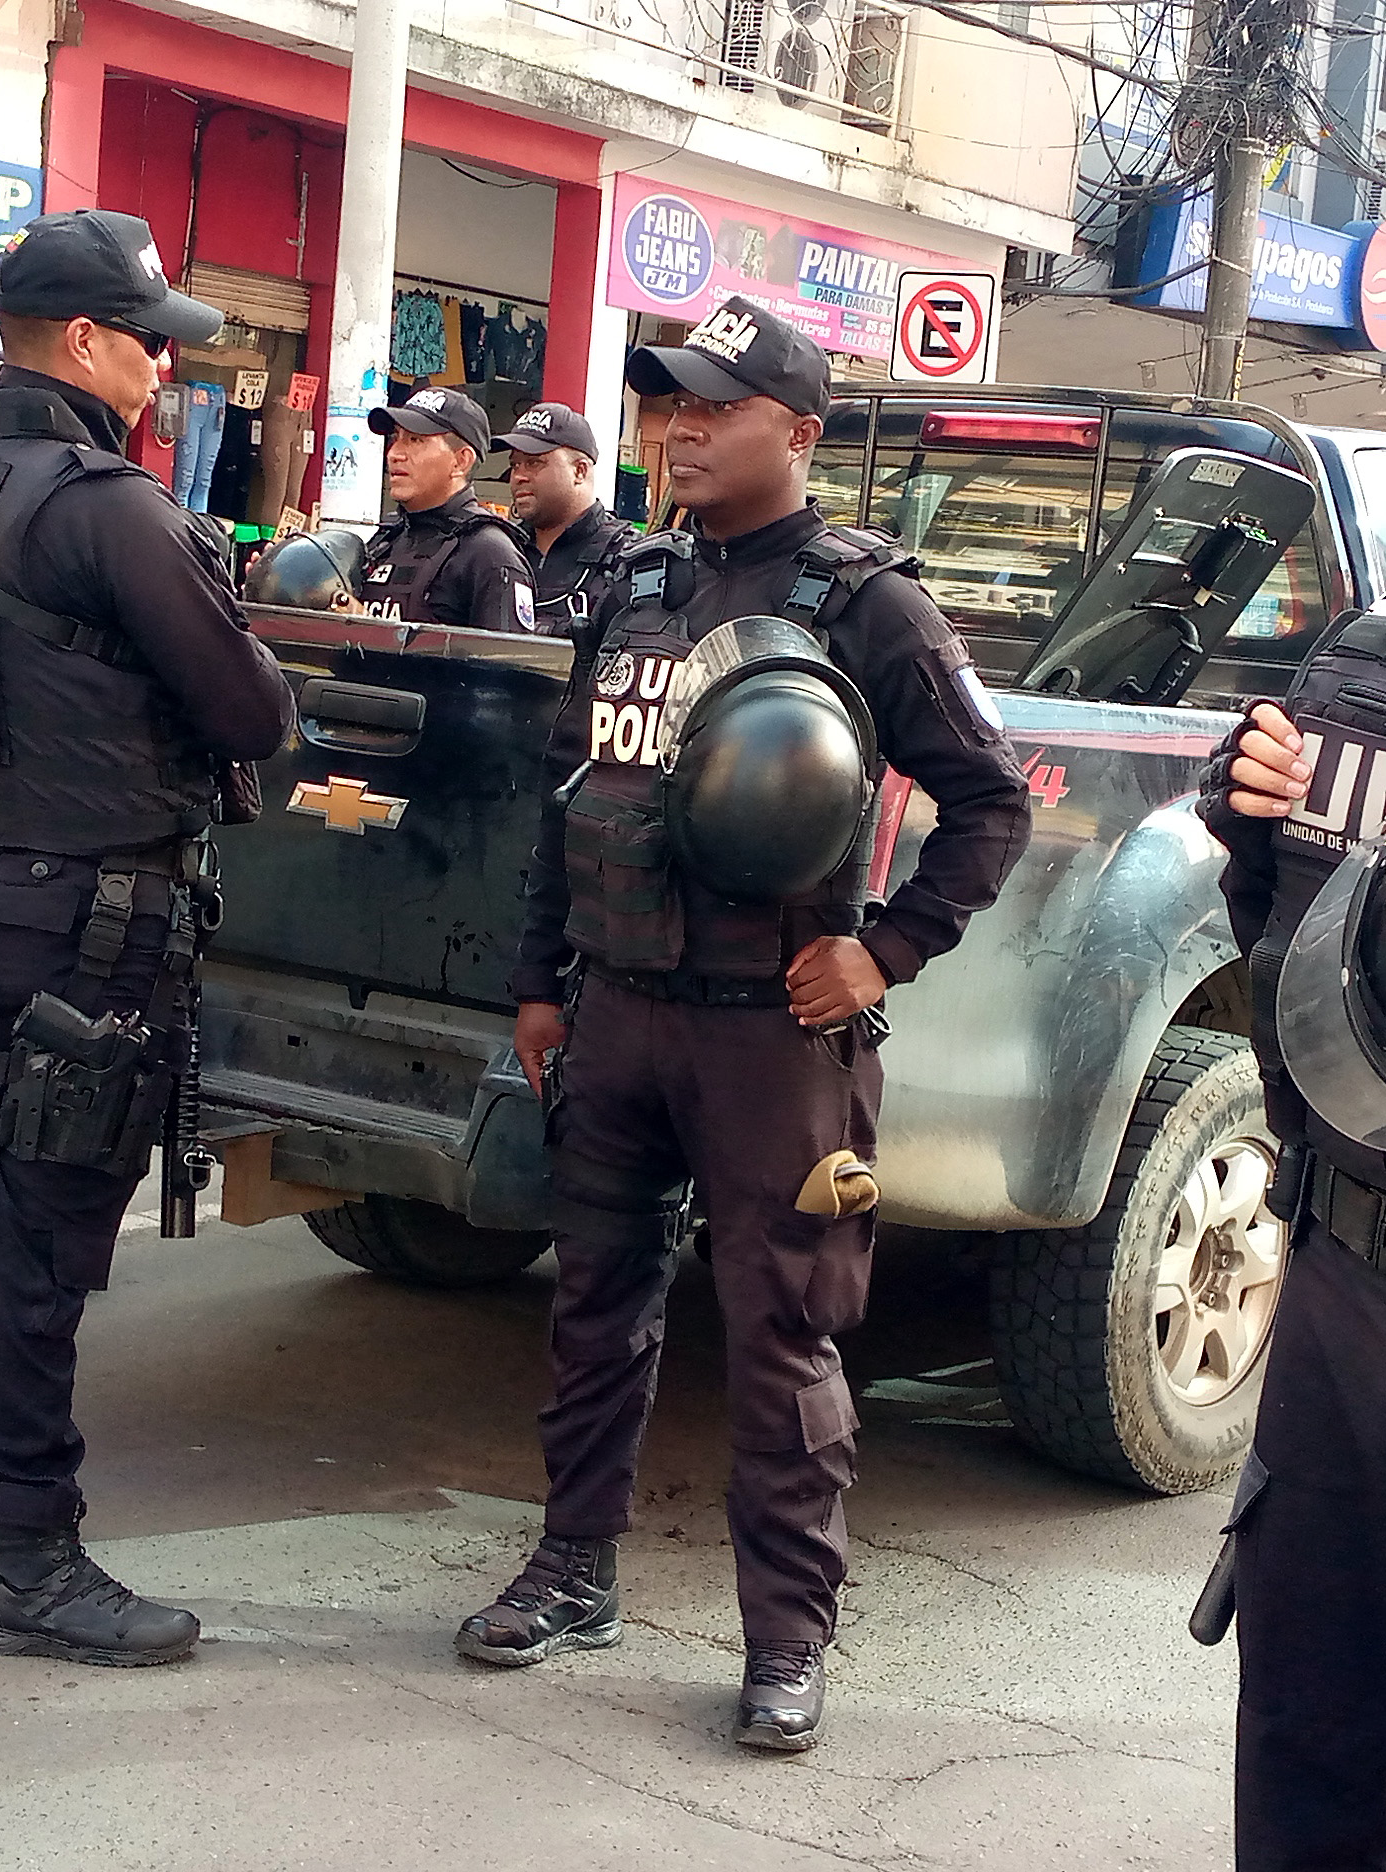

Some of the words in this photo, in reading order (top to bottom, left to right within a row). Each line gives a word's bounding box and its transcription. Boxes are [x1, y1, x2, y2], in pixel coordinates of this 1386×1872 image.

[644, 202, 698, 243] FABU
[635, 233, 701, 276] JEANS
[799, 241, 901, 297] PANTAL
[775, 298, 830, 322] Bermudas
[814, 287, 843, 307] PARA
[844, 293, 883, 314] DAMAS
[886, 302, 894, 316] Y
[689, 309, 760, 353] LICÍA
[839, 330, 881, 350] TALLAS
[920, 300, 963, 359] E
[363, 595, 403, 622] ICÍA
[590, 700, 660, 766] POL
[1282, 820, 1325, 846] UNIDAD
[1328, 834, 1344, 851] DE
